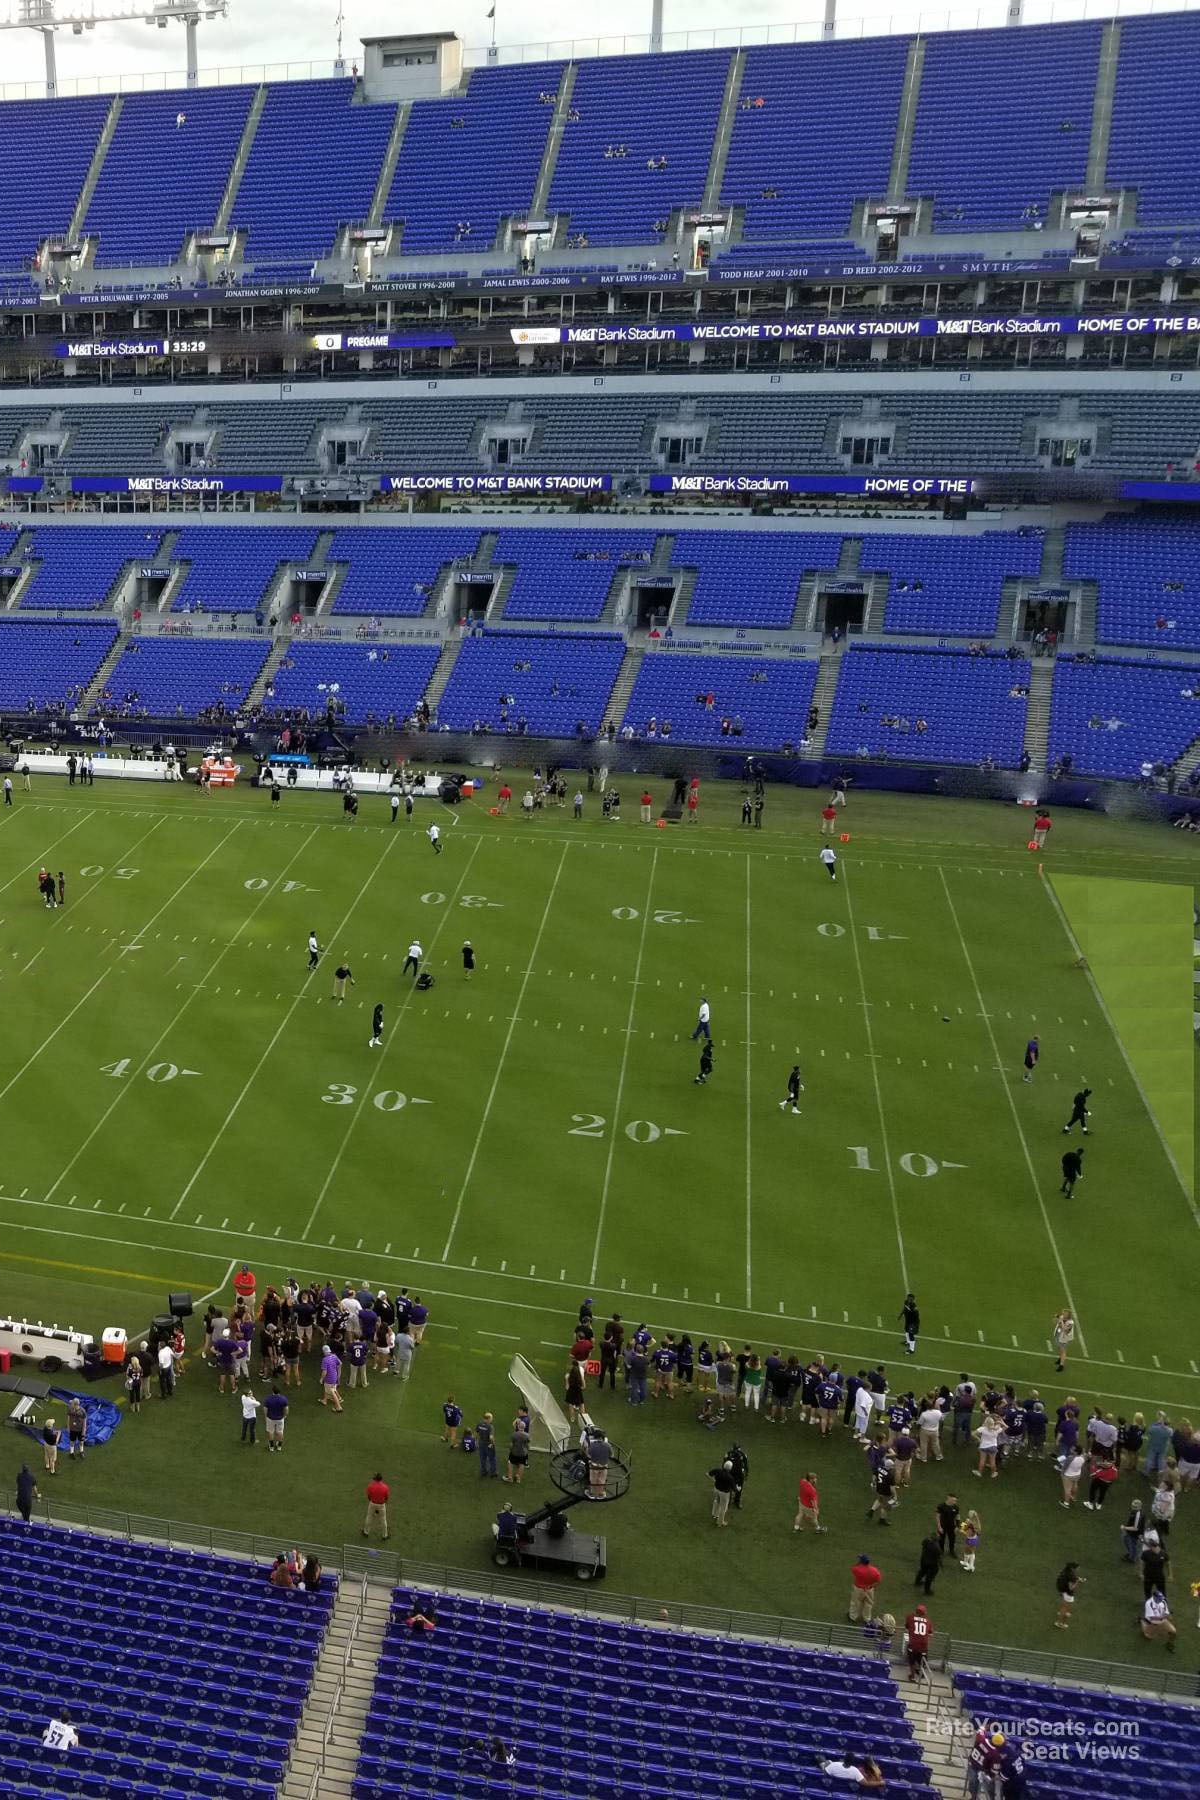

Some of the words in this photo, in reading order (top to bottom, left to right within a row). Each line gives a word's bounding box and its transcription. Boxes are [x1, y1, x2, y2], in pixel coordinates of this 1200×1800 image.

[720, 271, 741, 279] TODD
[743, 270, 764, 278] HEAP
[766, 269, 808, 278] 2001-2010
[843, 267, 854, 275] ED
[856, 266, 877, 274] REED
[878, 265, 923, 273] 2002-2012
[962, 263, 1010, 272] SMYTH
[482, 279, 507, 287] JAMAL
[508, 279, 529, 287] LEWIS
[531, 277, 570, 286] 2000-2006
[601, 275, 615, 283] RAY
[616, 274, 637, 282] LEWIS
[639, 273, 677, 281] 1996-2012
[225, 289, 258, 297] JONATHAN
[259, 289, 283, 297] OGDEN
[285, 287, 320, 295] 1996-2007
[371, 283, 390, 291] MATT
[391, 283, 417, 291] STOVER
[80, 295, 98, 303] PETER
[100, 294, 134, 302] BOULWARE
[693, 325, 760, 337] WELCOME
[763, 325, 779, 337] TO
[785, 324, 815, 336] M&T
[817, 323, 855, 335] BANK
[858, 322, 919, 334] STADIUM
[936, 320, 971, 334] M&T
[971, 320, 1004, 332] Bank
[1005, 319, 1060, 332] Stadium
[1078, 319, 1123, 332] HOME
[1126, 319, 1149, 331] OF
[1153, 318, 1191, 331] THE
[568, 328, 598, 341] M&T
[598, 328, 627, 341] Bank
[627, 327, 675, 340] Stadium
[172, 342, 206, 352] 33:29
[347, 336, 388, 347] PREGAME
[68, 344, 93, 356] M&T
[93, 343, 118, 355] Bank
[118, 342, 158, 355] Stadium
[128, 478, 155, 490] M&T
[155, 478, 180, 489] Bank
[180, 477, 223, 490] Stadium
[390, 477, 453, 489] WELCOME
[456, 477, 474, 489] TO
[477, 477, 504, 489] M&T
[507, 477, 542, 489] BANK
[545, 476, 602, 489] STADIUM
[671, 477, 704, 490] M&T
[704, 477, 735, 489] Bank
[736, 476, 789, 490] Stadium
[865, 478, 909, 491] HOME
[912, 479, 933, 491] OF
[937, 479, 967, 492] THE
[99, 1058, 178, 1082] 40
[321, 1083, 407, 1111] 30
[567, 1113, 661, 1143] 20
[847, 1146, 938, 1177] 10
[587, 1362, 600, 1373] 20
[823, 1391, 834, 1400] 57
[891, 1413, 904, 1424] 52
[914, 1622, 927, 1636] 10
[48, 1730, 64, 1746] 57
